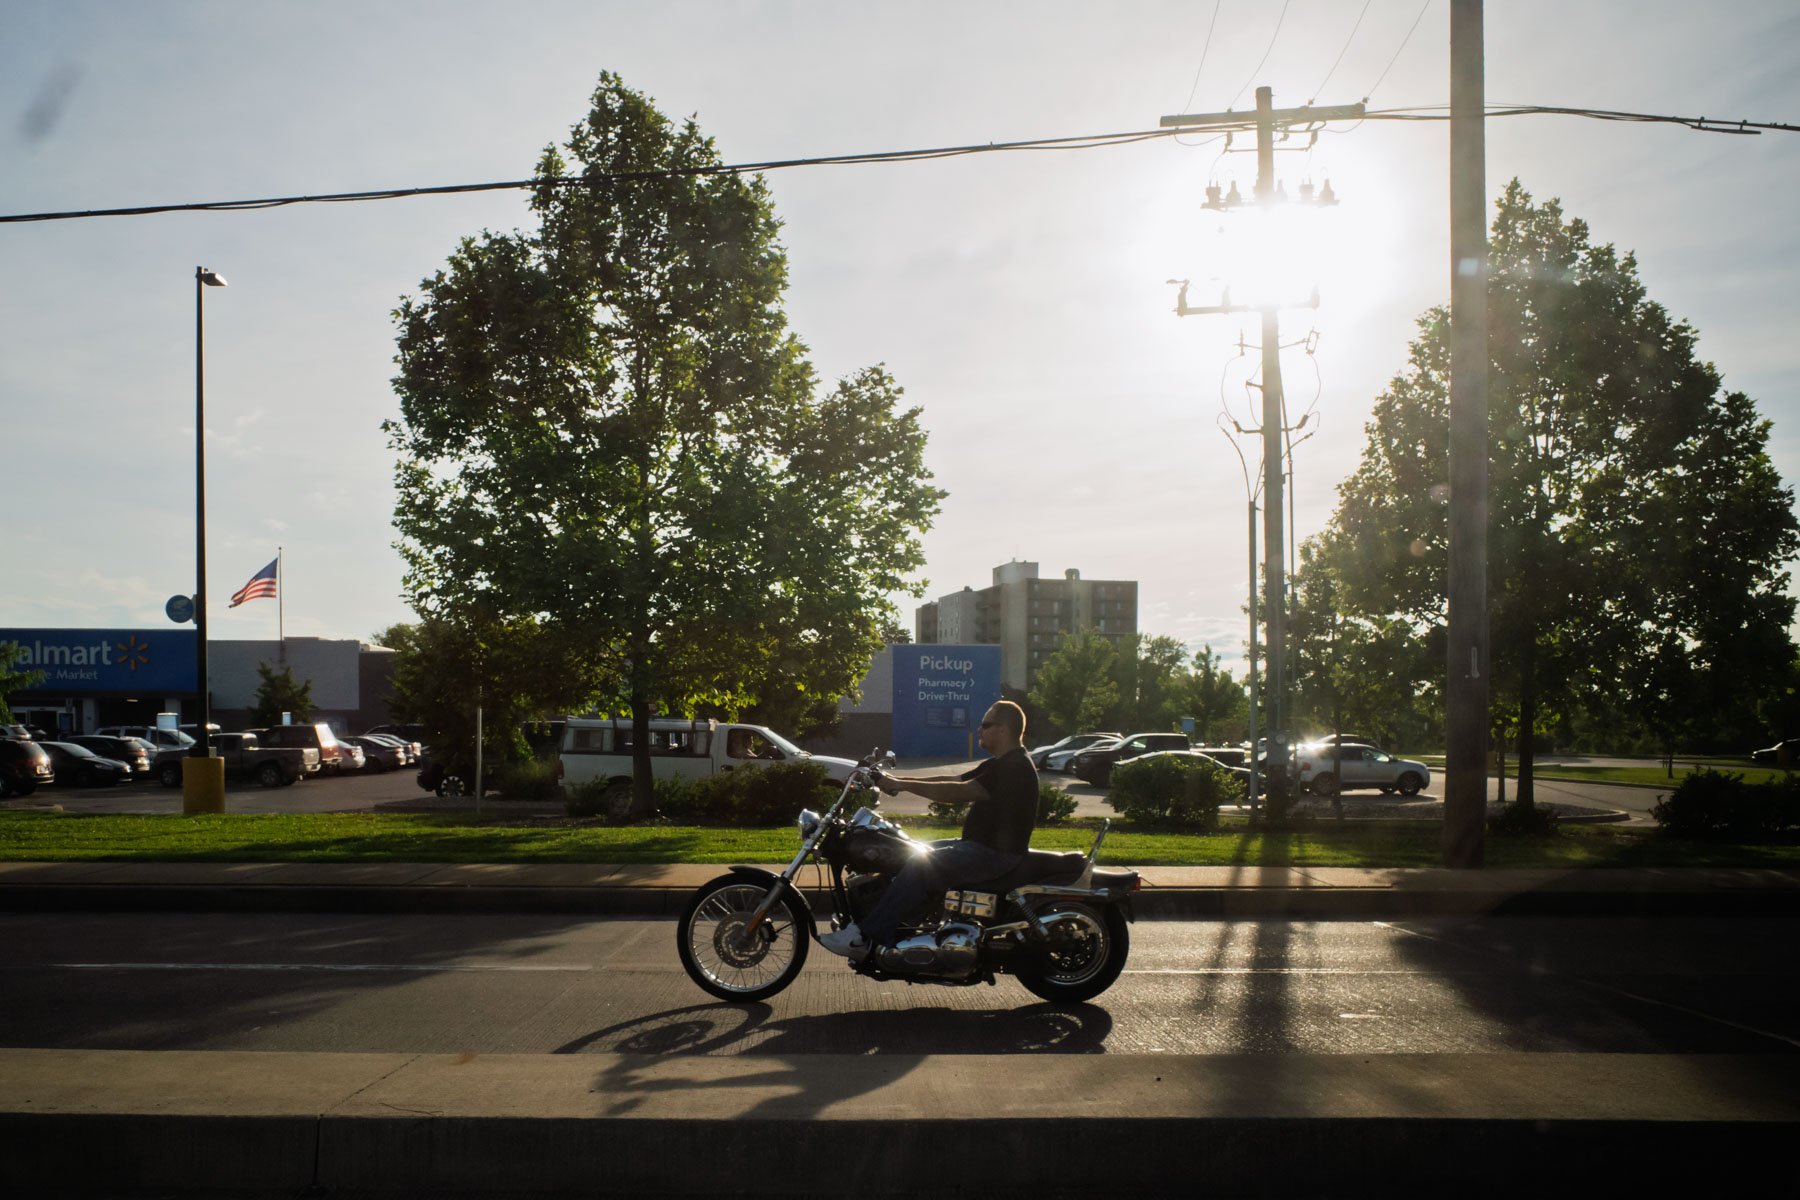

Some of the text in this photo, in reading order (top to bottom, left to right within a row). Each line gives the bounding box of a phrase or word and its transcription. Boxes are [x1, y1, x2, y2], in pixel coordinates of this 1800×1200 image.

[920, 656, 973, 674] Pickup
[56, 668, 99, 680] Market
[918, 678, 967, 689] Pharmacy
[918, 691, 970, 701] Drive-Thru
